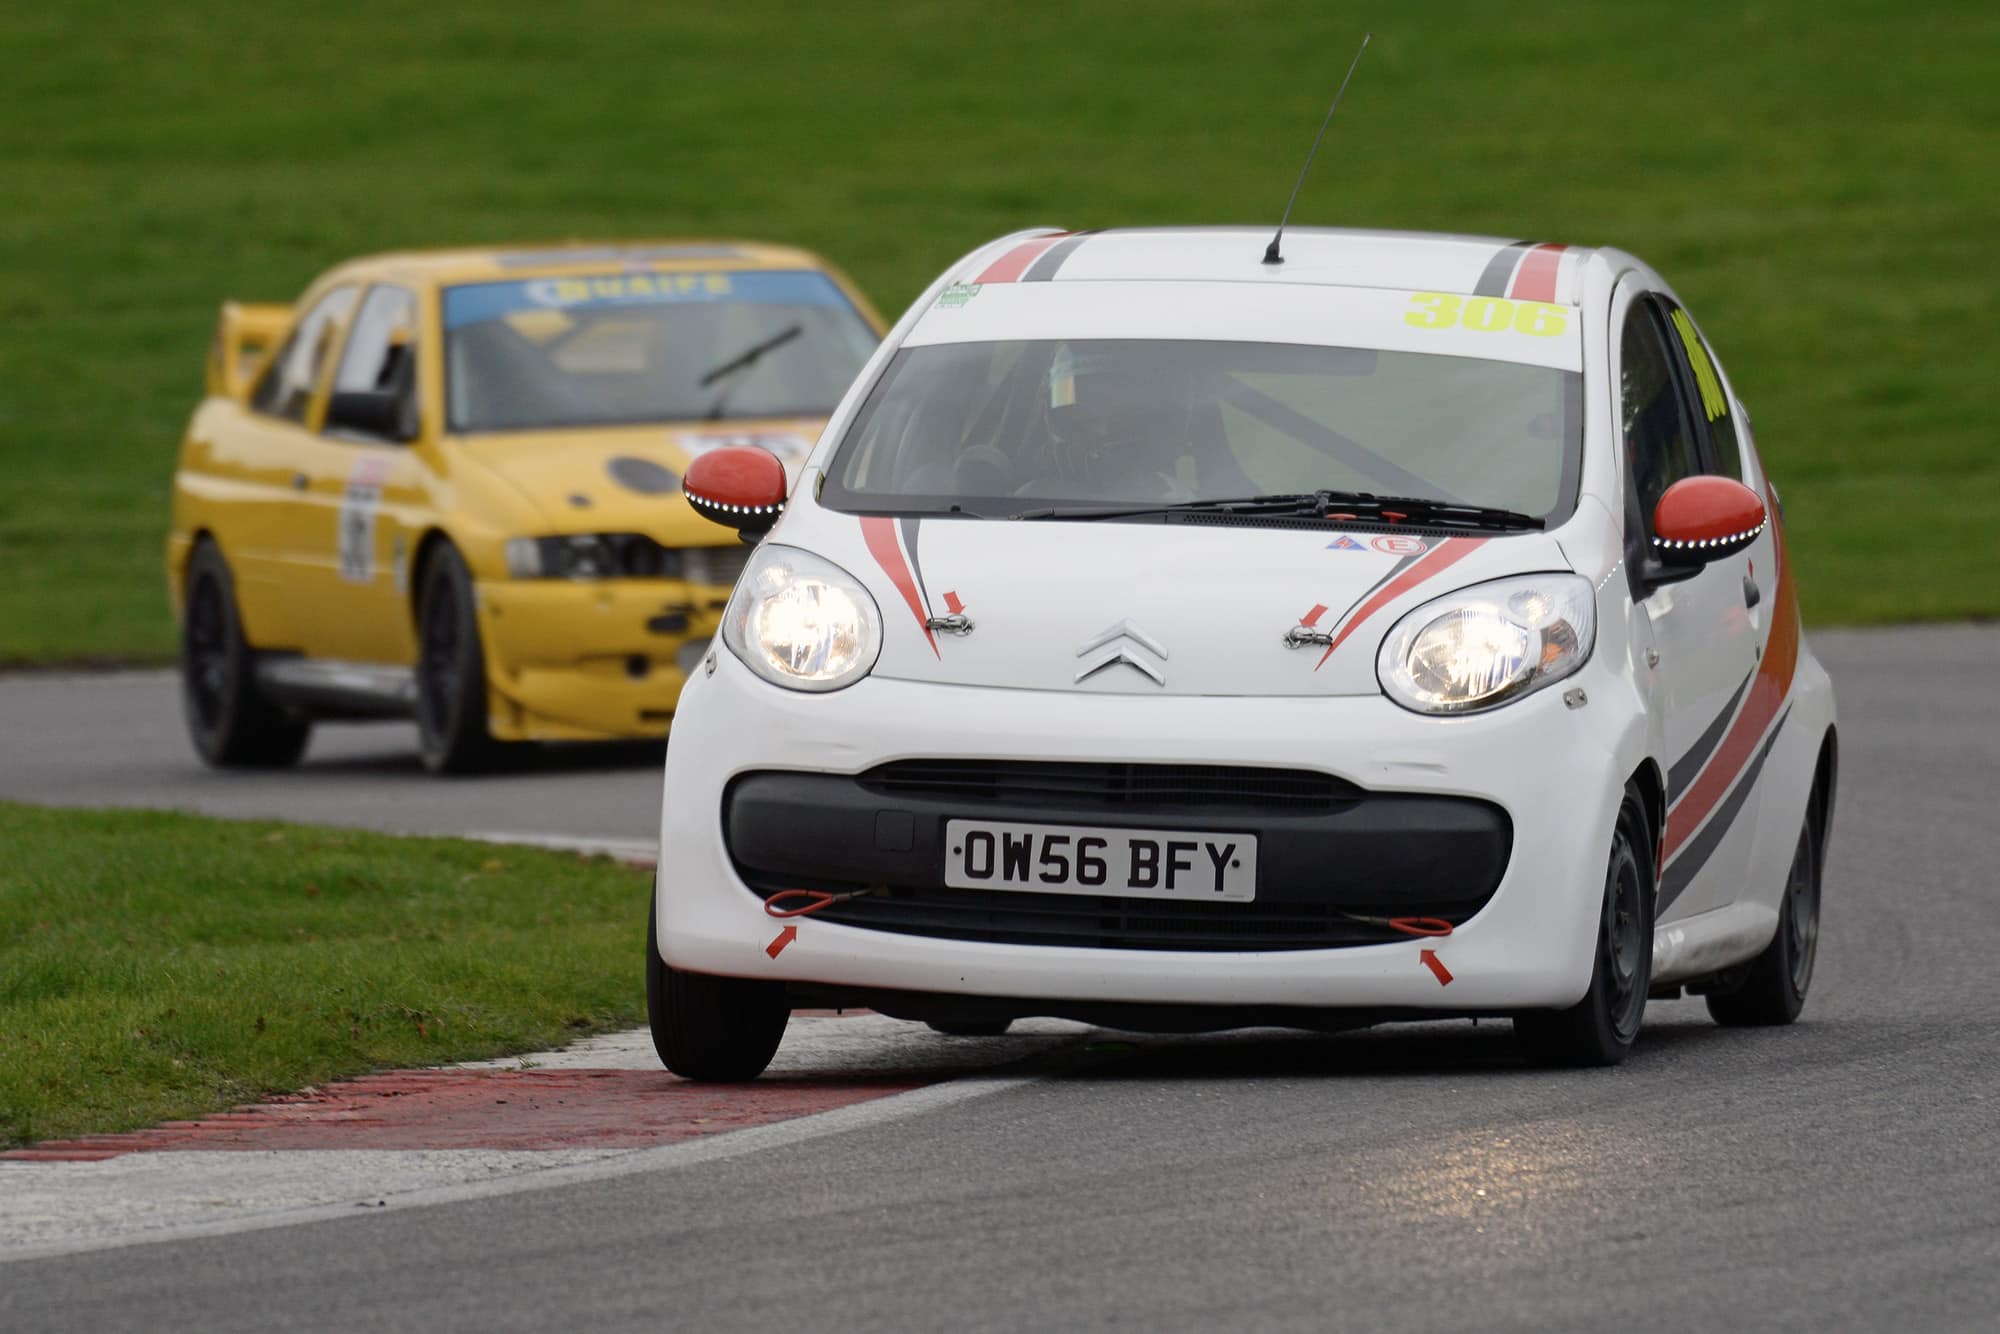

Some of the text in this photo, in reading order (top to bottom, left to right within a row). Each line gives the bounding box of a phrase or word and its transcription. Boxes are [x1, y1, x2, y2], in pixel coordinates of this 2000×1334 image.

[1404, 292, 1568, 337] 306
[964, 830, 1236, 892] OW56 BFY
